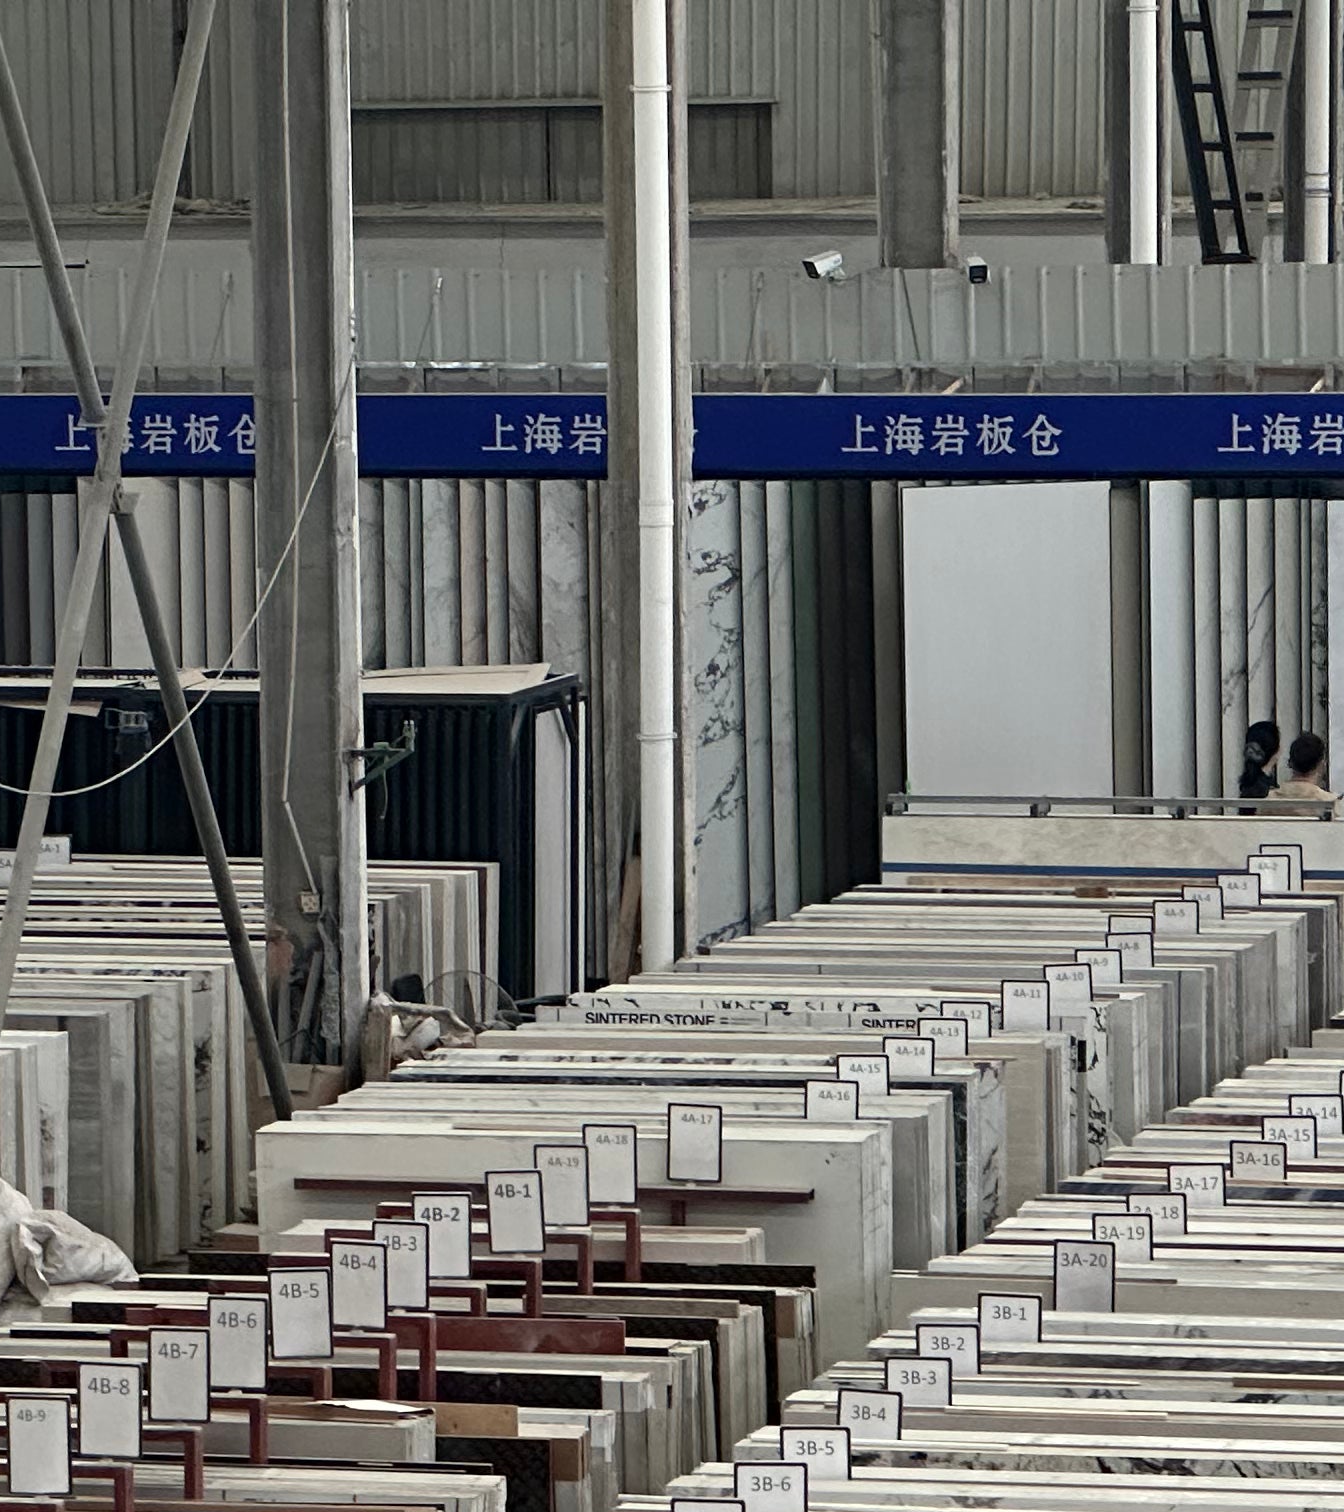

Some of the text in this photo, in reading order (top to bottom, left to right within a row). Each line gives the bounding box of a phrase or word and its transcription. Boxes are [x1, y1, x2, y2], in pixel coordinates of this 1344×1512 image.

[841, 414, 1062, 455] 上海岩板仓
[1269, 1128, 1310, 1142] 3A-15
[1237, 1152, 1280, 1166] 3A-16
[1175, 1177, 1218, 1190] 3A-17
[495, 1184, 531, 1198] 4B-1
[421, 1207, 459, 1221] 4B-2
[1100, 1226, 1145, 1240] 3A-19
[340, 1254, 376, 1270] 4B-4
[1062, 1253, 1107, 1268] 3A-20
[279, 1283, 319, 1298] 4B-5
[217, 1312, 257, 1328] 4B-6
[993, 1306, 1026, 1320] 3B-1
[932, 1336, 964, 1350] 3B-2
[158, 1343, 198, 1359] 4B-7
[901, 1371, 936, 1385] 3B-3
[88, 1378, 130, 1395] 4B-8
[17, 1410, 46, 1422] 4B-9
[852, 1405, 886, 1421] 3B-4
[797, 1441, 834, 1455] 3B-5
[752, 1476, 791, 1491] 3B-6
